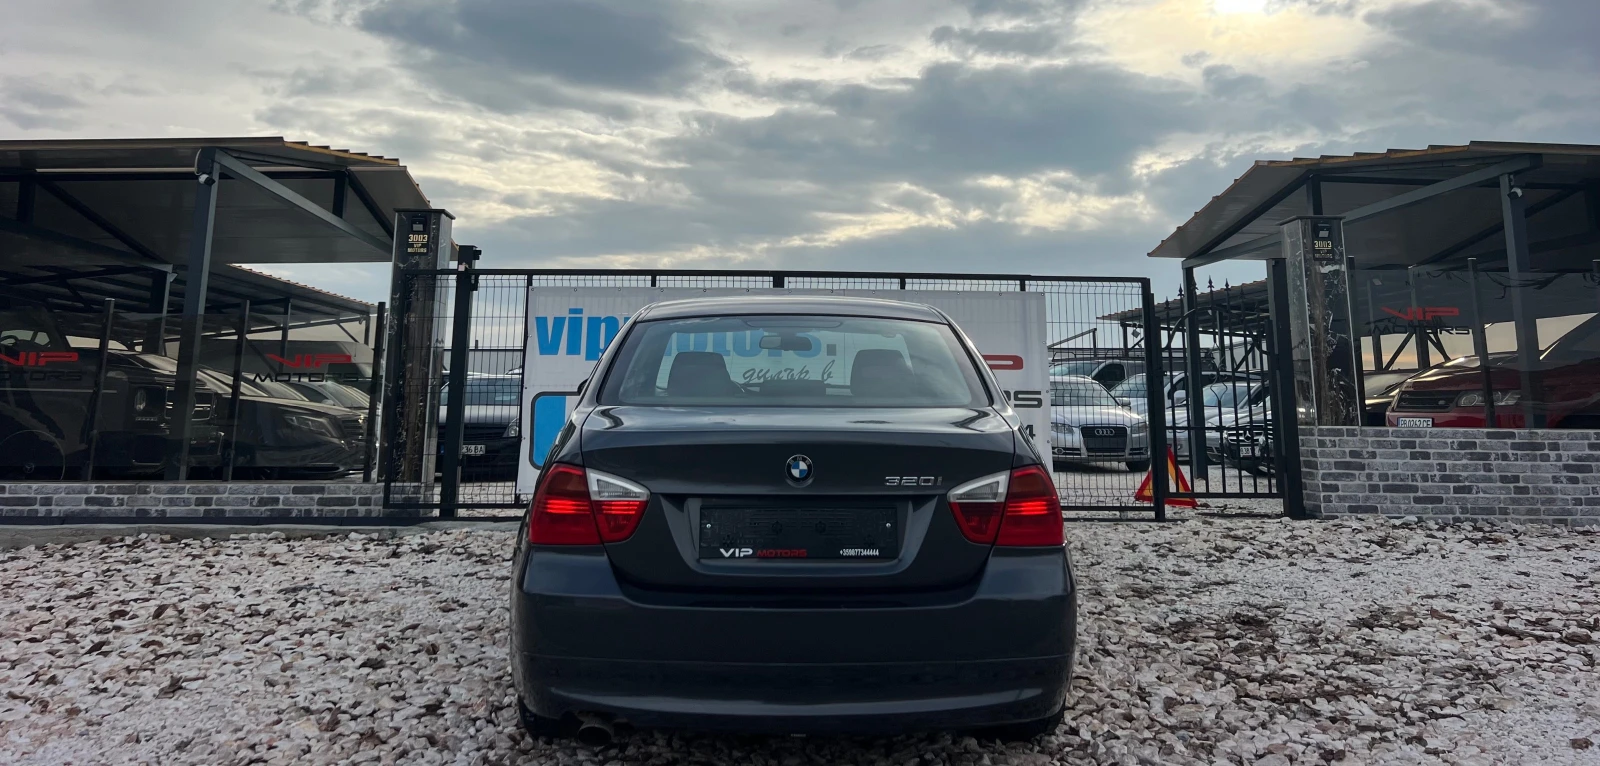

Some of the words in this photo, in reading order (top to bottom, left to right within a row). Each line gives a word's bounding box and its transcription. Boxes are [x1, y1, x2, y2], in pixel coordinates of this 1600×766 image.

[408, 234, 428, 242] 3003
[1380, 306, 1460, 321] VIP
[0, 351, 79, 367] VIP
[265, 353, 352, 368] VIP
[0, 370, 84, 382] OTORS
[252, 372, 359, 383] MOTORS
[884, 476, 943, 486] 320i
[719, 548, 753, 558] VIP
[756, 548, 808, 558] MOTORS
